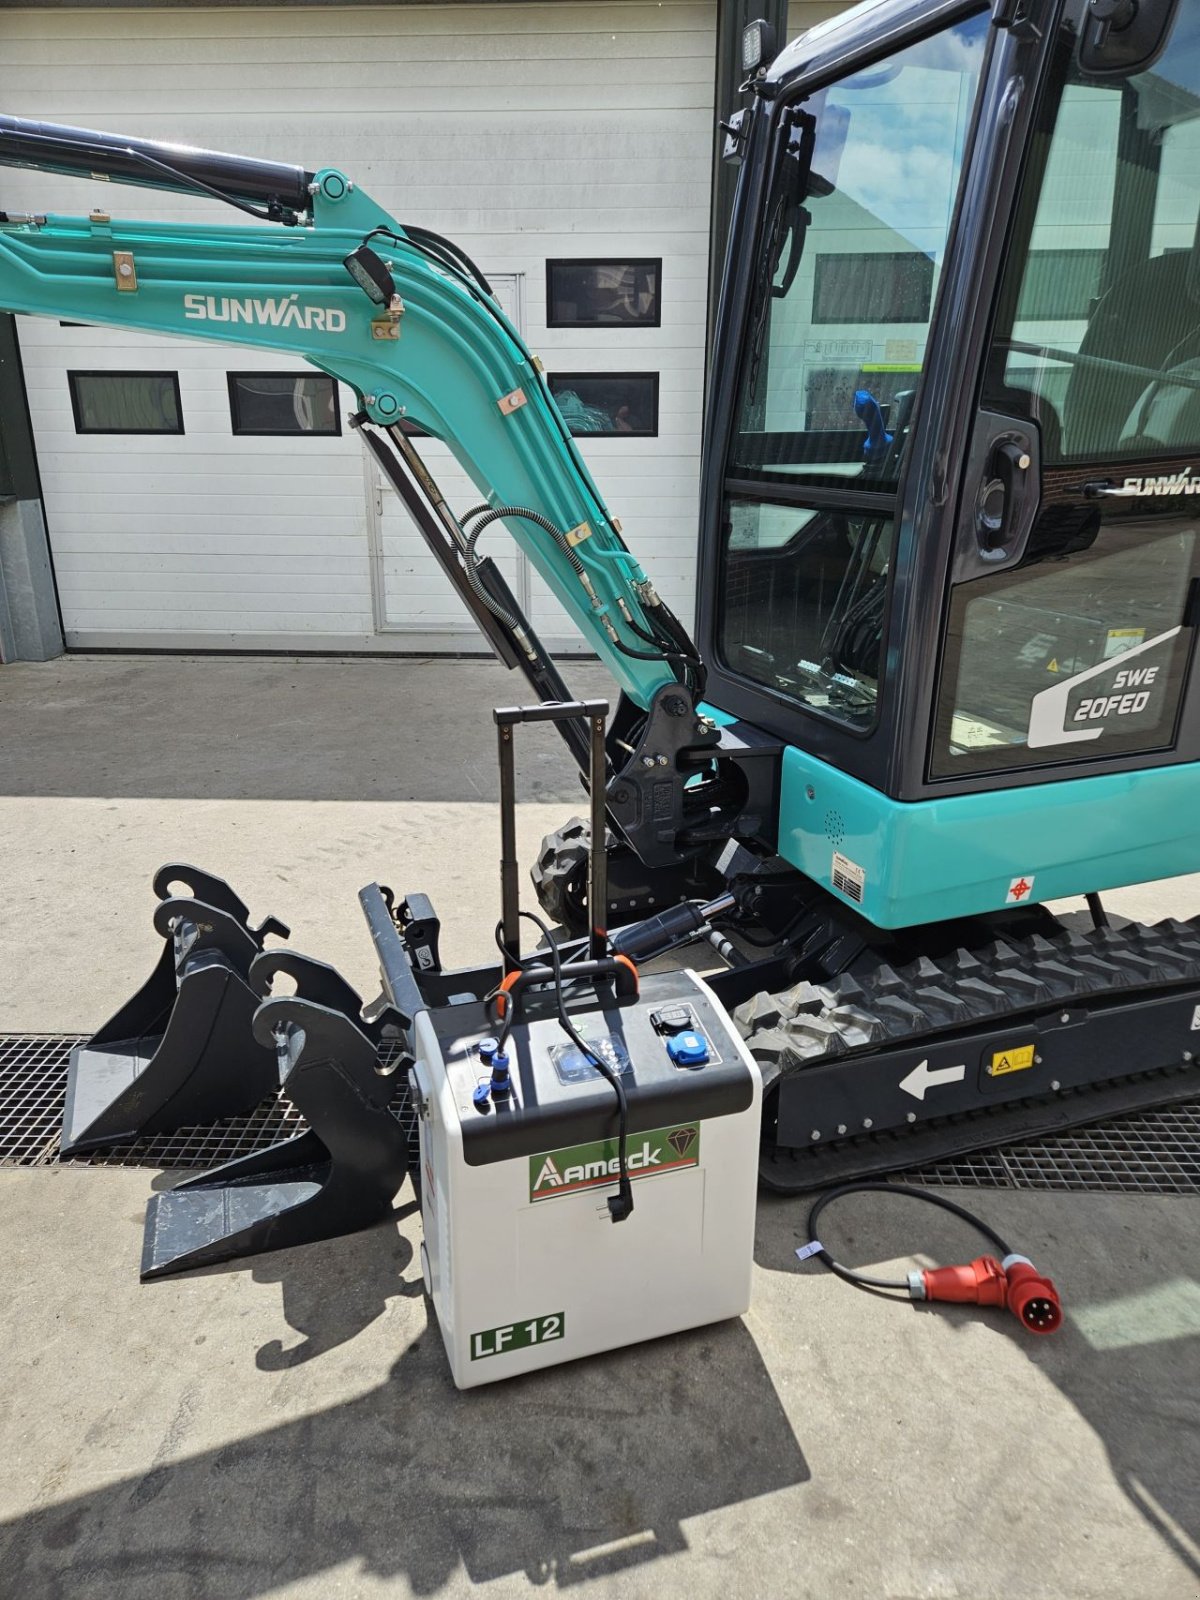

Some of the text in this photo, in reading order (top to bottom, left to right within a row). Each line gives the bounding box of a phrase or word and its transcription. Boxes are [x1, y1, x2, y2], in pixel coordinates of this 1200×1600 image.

[184, 293, 346, 333] SUNWARD
[1112, 666, 1160, 689] SWE
[1073, 691, 1151, 722] 20FED
[475, 1317, 560, 1358] LF 12
